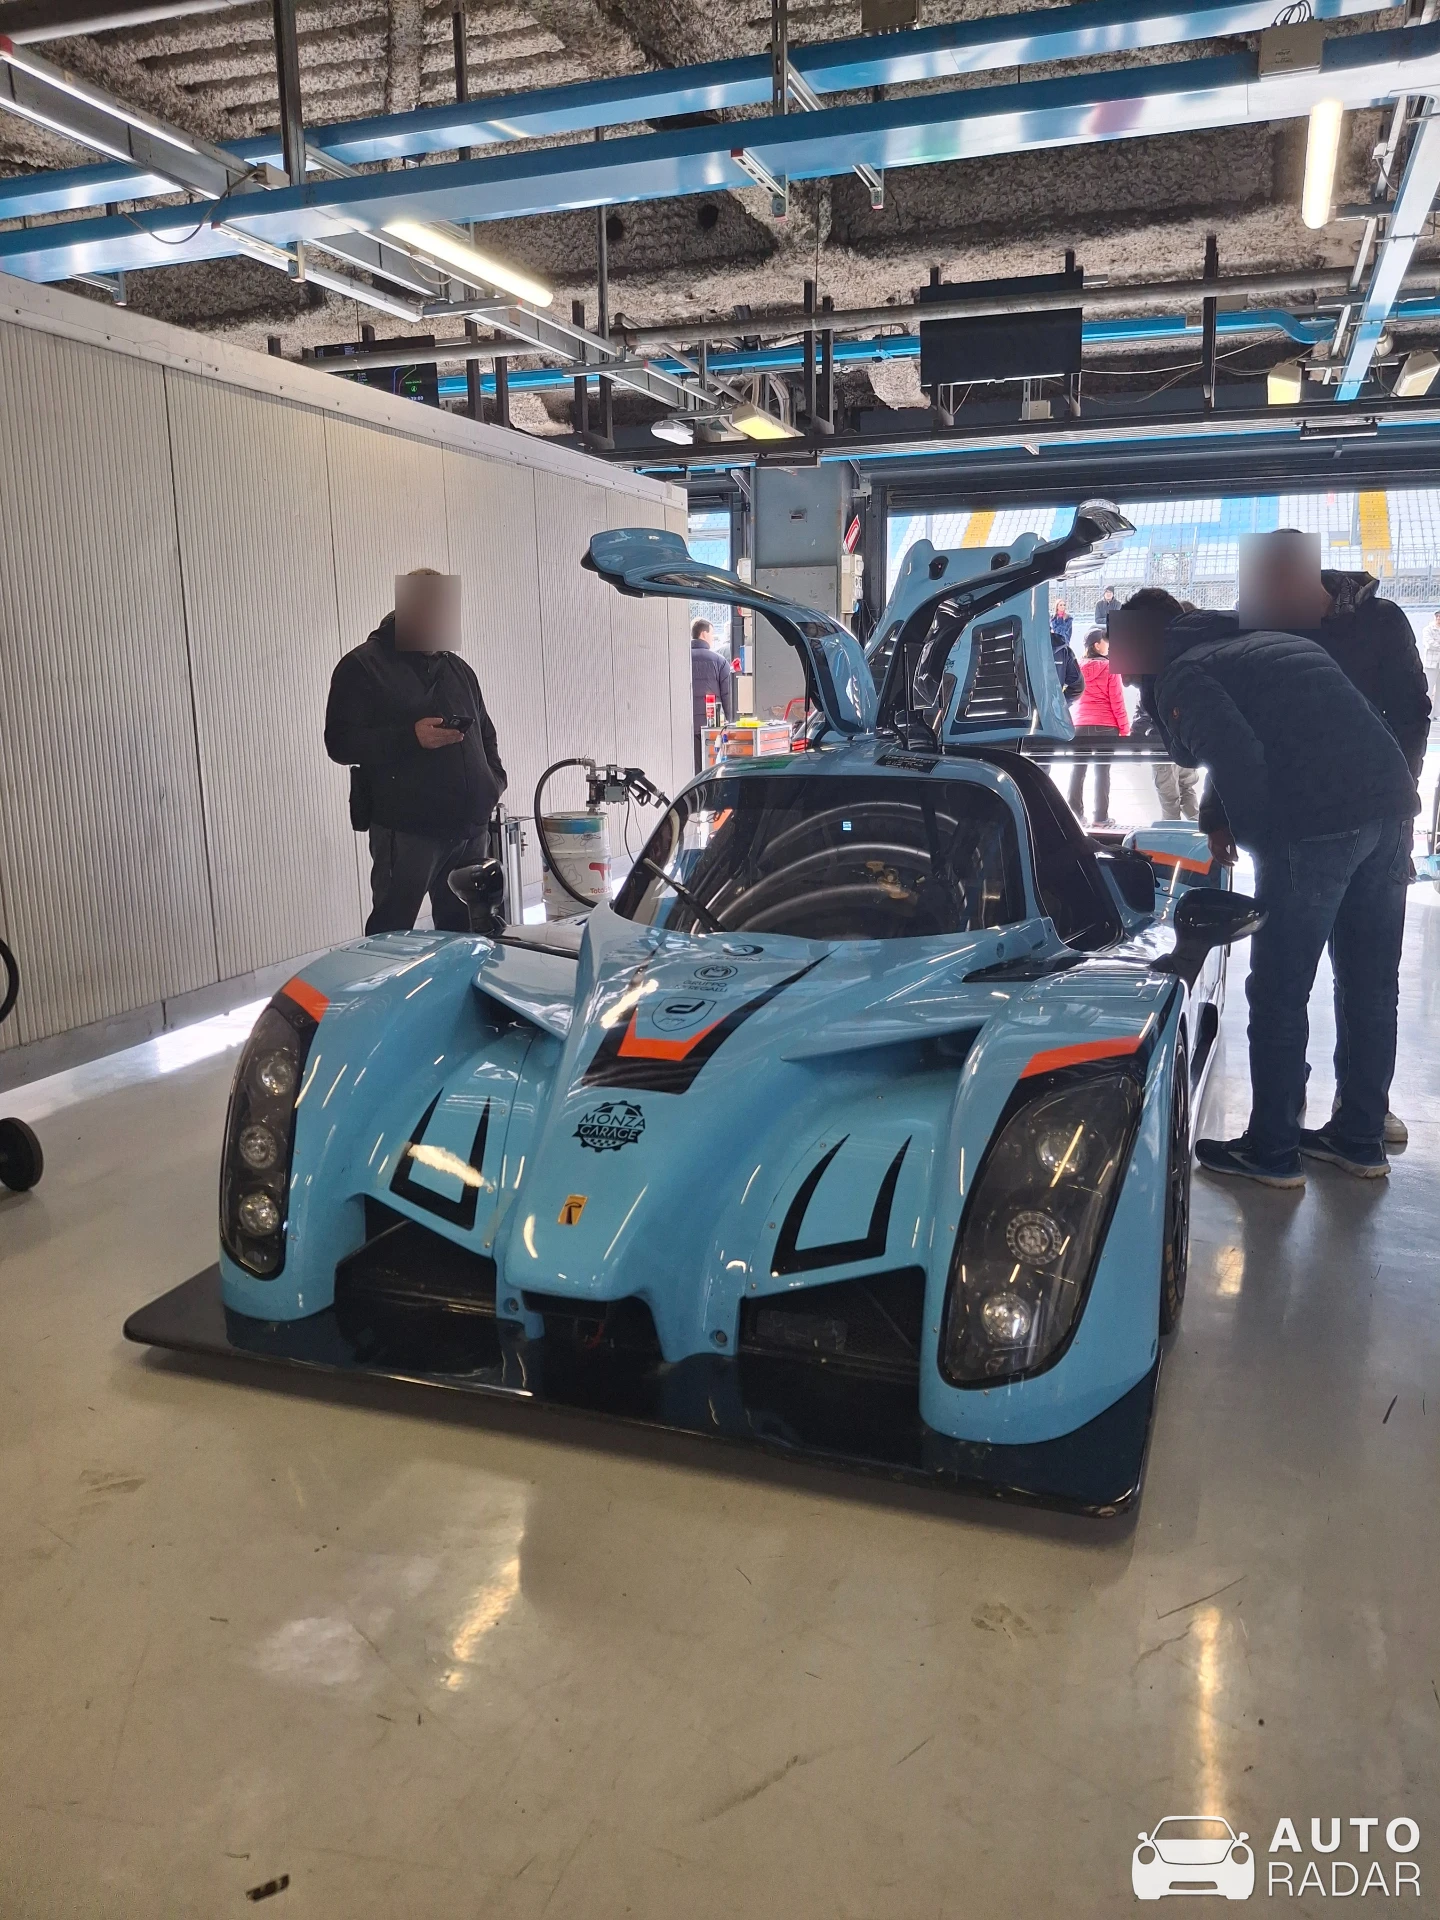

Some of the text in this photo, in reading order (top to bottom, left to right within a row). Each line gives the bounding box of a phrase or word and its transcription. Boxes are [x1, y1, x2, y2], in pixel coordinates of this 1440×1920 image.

[683, 979, 727, 988] GRUPPO
[579, 1112, 646, 1130] MONZA
[579, 1124, 639, 1140] GARAGE
